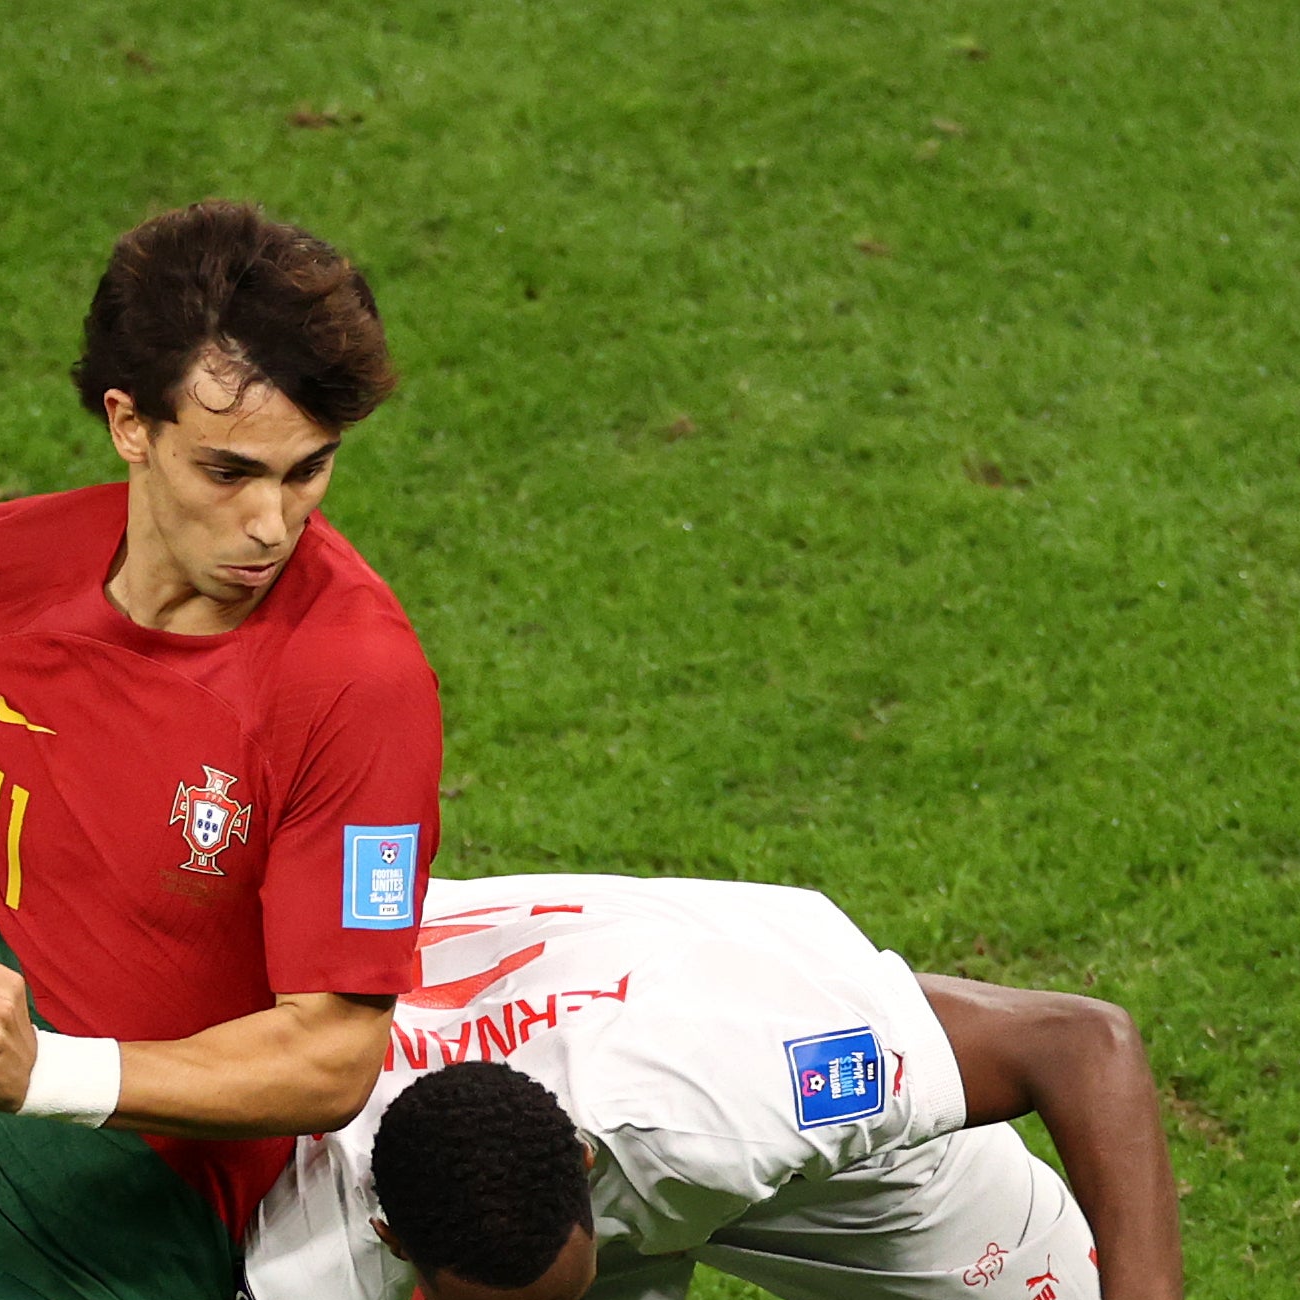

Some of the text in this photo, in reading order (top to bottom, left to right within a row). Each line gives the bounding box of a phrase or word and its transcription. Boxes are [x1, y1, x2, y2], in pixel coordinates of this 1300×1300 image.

[371, 868, 403, 880] FOOTBALL
[371, 879, 404, 891] UNITES
[828, 1058, 842, 1099] FOOTBALL
[840, 1056, 854, 1097] UNITES
[851, 1052, 866, 1096] the World
